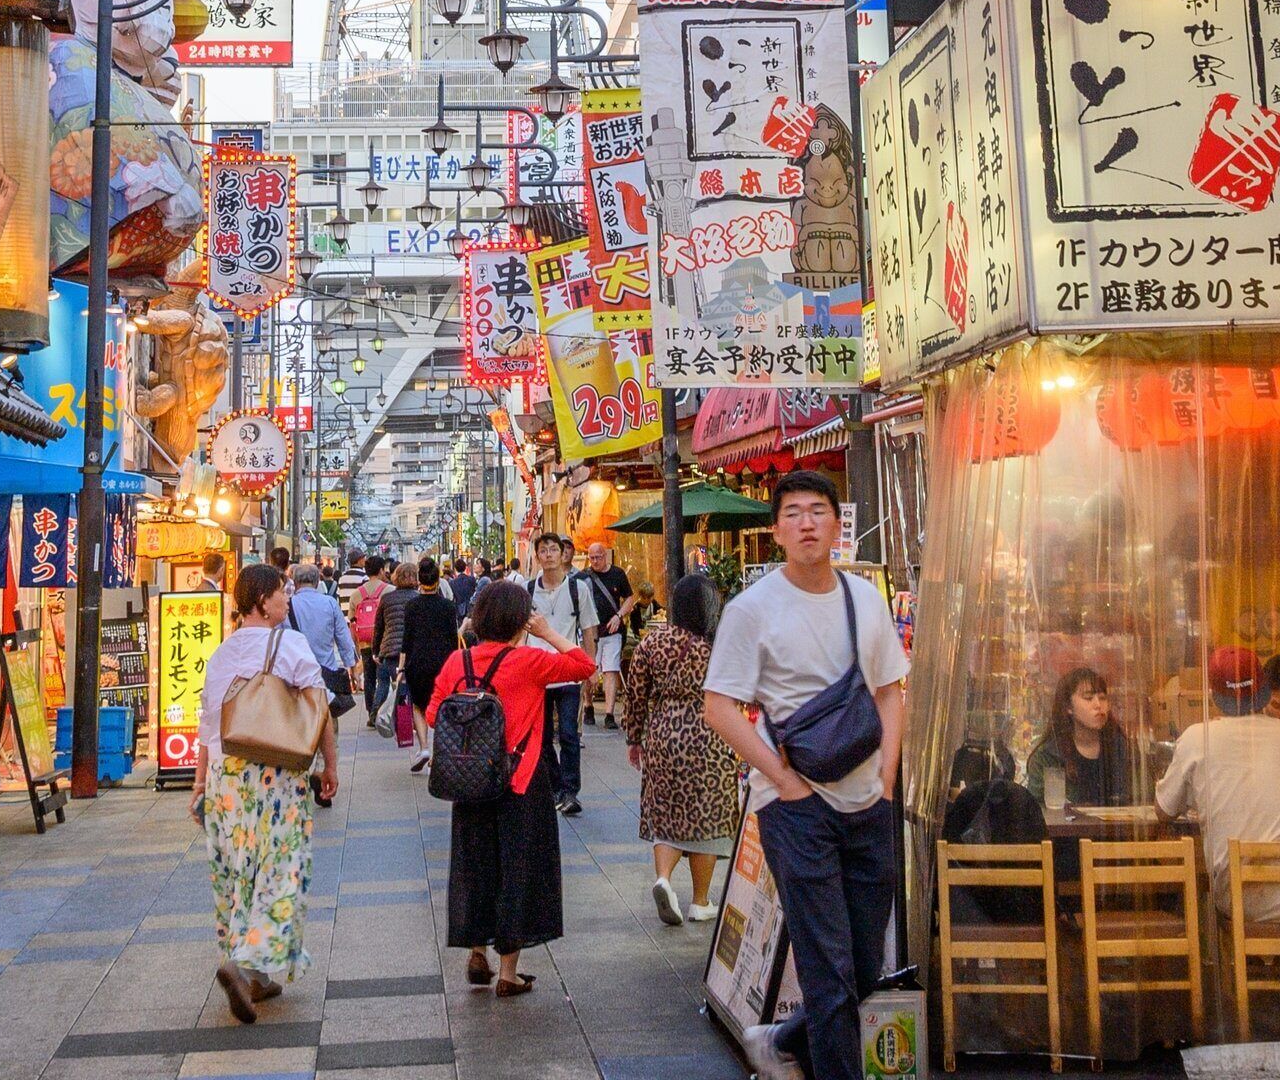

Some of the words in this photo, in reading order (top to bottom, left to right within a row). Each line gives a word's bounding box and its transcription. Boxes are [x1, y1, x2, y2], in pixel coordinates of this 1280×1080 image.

[189, 44, 273, 60] 24時間営業中
[760, 37, 789, 94] 新世界
[589, 116, 644, 140] 新世界
[595, 171, 623, 251] 大阪名物
[700, 167, 804, 197] 総本店
[215, 169, 243, 275] お好み焼き
[245, 168, 286, 273] 串かつ
[660, 210, 797, 275] 大阪名物
[976, 132, 999, 316] 専門店
[1056, 238, 1088, 268] 1F
[493, 255, 533, 346] 串かつ
[1056, 282, 1090, 312] 2F
[665, 343, 857, 377] 宴会予約受付中
[572, 376, 659, 440] 299円
[32, 507, 60, 584] 串かつ
[165, 603, 219, 617] 大衆酒場
[169, 621, 190, 703] ホルモン
